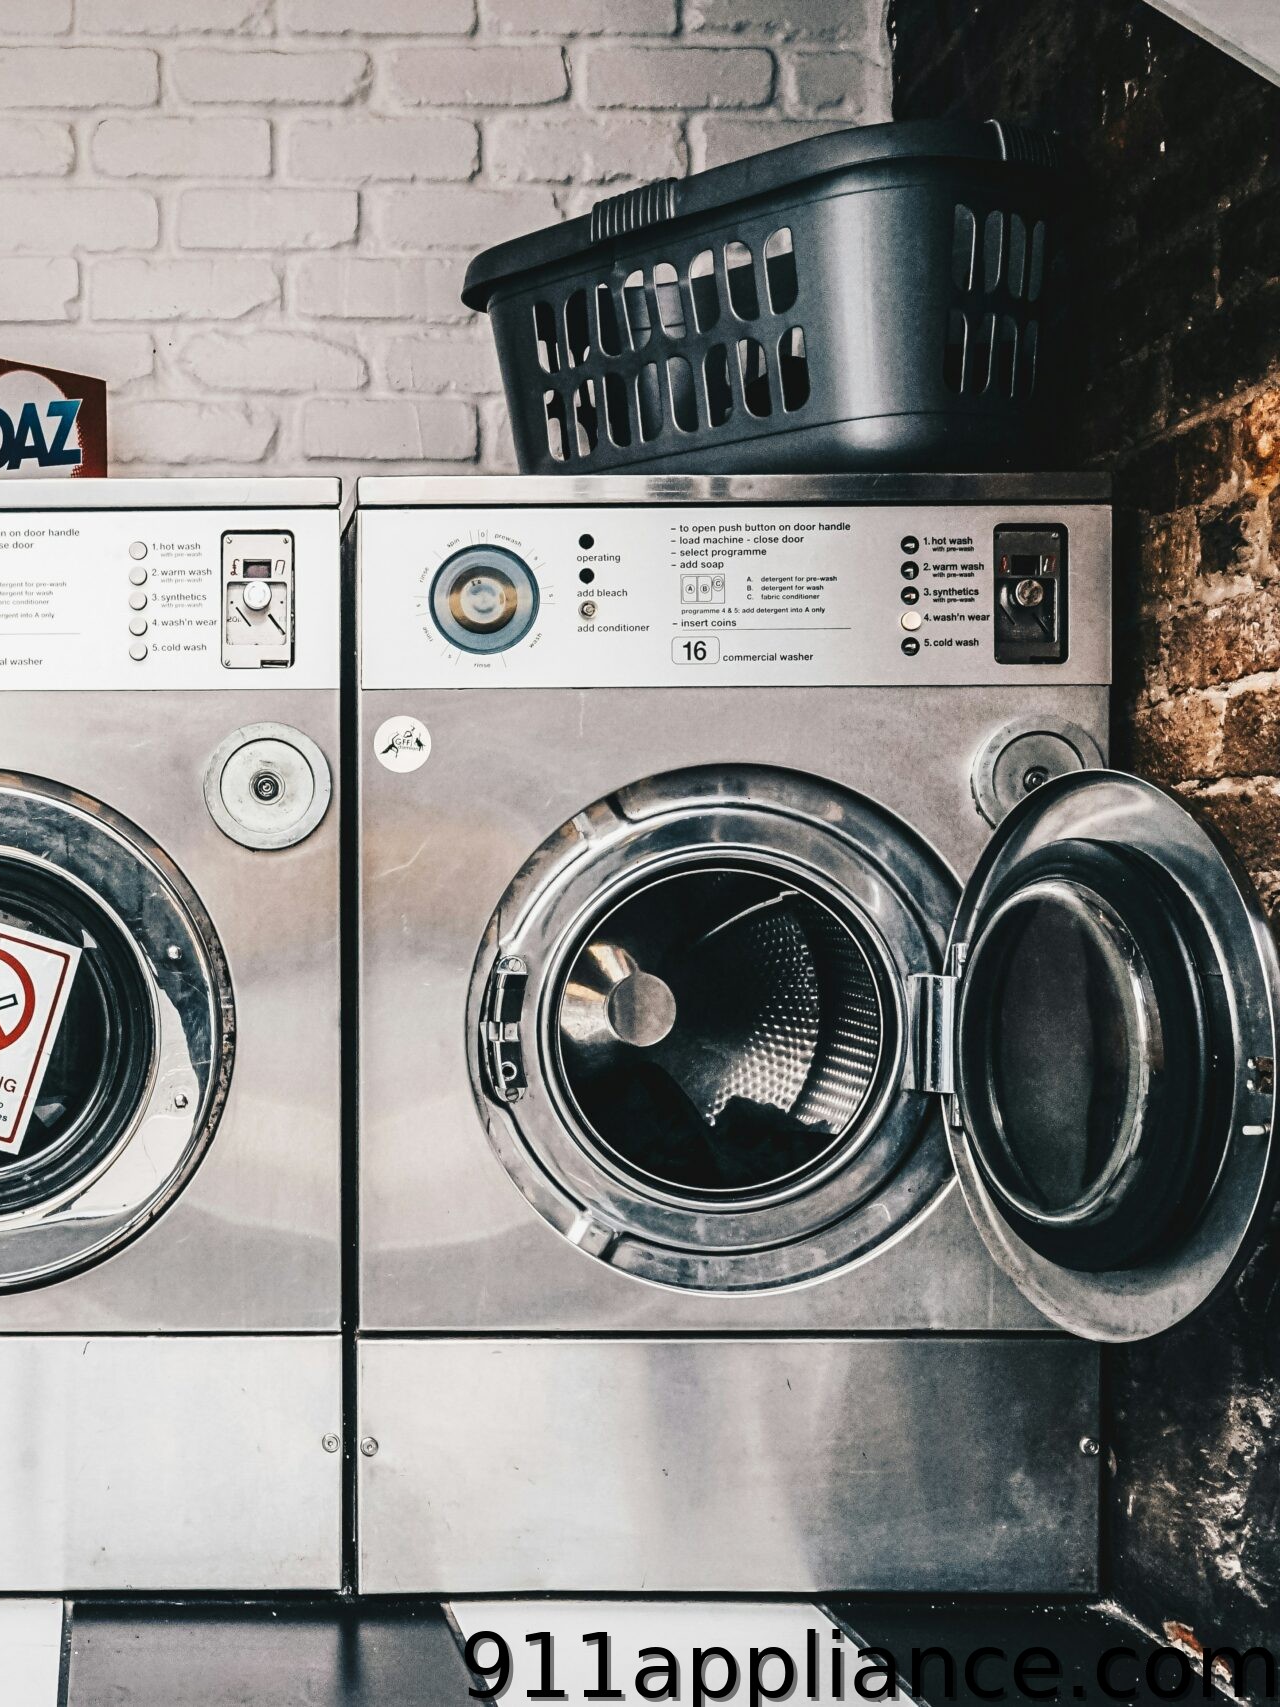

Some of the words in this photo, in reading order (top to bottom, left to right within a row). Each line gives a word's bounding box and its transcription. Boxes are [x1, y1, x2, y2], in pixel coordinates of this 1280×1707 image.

[23, 528, 46, 537] door
[48, 528, 80, 537] handle
[679, 524, 690, 533] to
[691, 525, 716, 534] open
[718, 523, 742, 534] push
[744, 523, 776, 532] button
[778, 524, 791, 532] on
[793, 522, 817, 532] door
[818, 521, 851, 531] handle
[679, 535, 701, 545] load
[702, 535, 744, 545] machine
[753, 535, 780, 544] close
[781, 534, 805, 544] door
[923, 536, 931, 546] 1.
[931, 536, 947, 546] hot
[948, 536, 974, 546] wash
[12, 540, 34, 550] door
[152, 543, 159, 551] 1.
[159, 542, 175, 551] hot
[177, 542, 201, 551] wash
[931, 545, 946, 553] with
[945, 545, 975, 553] pre-wash
[679, 548, 709, 557] select
[711, 548, 767, 558] programme
[576, 553, 621, 564] operating
[679, 560, 698, 569] add
[700, 561, 725, 570] soap
[922, 562, 932, 572] 2.
[931, 563, 958, 572] warm
[960, 561, 985, 571] wash
[151, 567, 160, 577] 2.
[188, 567, 213, 576] wash
[946, 571, 975, 579] pre-wash
[760, 576, 794, 584] detergent
[805, 575, 838, 583] pre-wash
[576, 588, 595, 598] add
[596, 588, 628, 597] bleach
[760, 584, 794, 593] detergent
[923, 587, 932, 597] 3.
[932, 586, 980, 597] synthetics
[151, 593, 160, 602] 3.
[160, 592, 207, 603] synthetics
[760, 593, 781, 601] fabric
[946, 596, 976, 604] pre-wash
[680, 608, 721, 616] programme
[755, 607, 789, 615] detergent
[811, 606, 826, 615] only
[923, 613, 932, 622] 4.
[932, 612, 966, 622] wash'n
[967, 614, 991, 622] wear
[151, 618, 160, 627] 4.
[160, 618, 193, 627] wash'n
[680, 619, 709, 628] insert
[710, 618, 737, 627] coins
[577, 623, 595, 633] add
[597, 623, 651, 633] conditioner
[923, 638, 933, 647] 5.
[932, 637, 954, 647] cold
[954, 637, 980, 647] wash
[152, 643, 160, 652] 5.
[161, 643, 181, 652] cold
[183, 643, 207, 652] wash
[683, 641, 706, 661] 16
[9, 657, 44, 666] washer
[722, 652, 777, 662] commercial
[779, 652, 814, 662] washer
